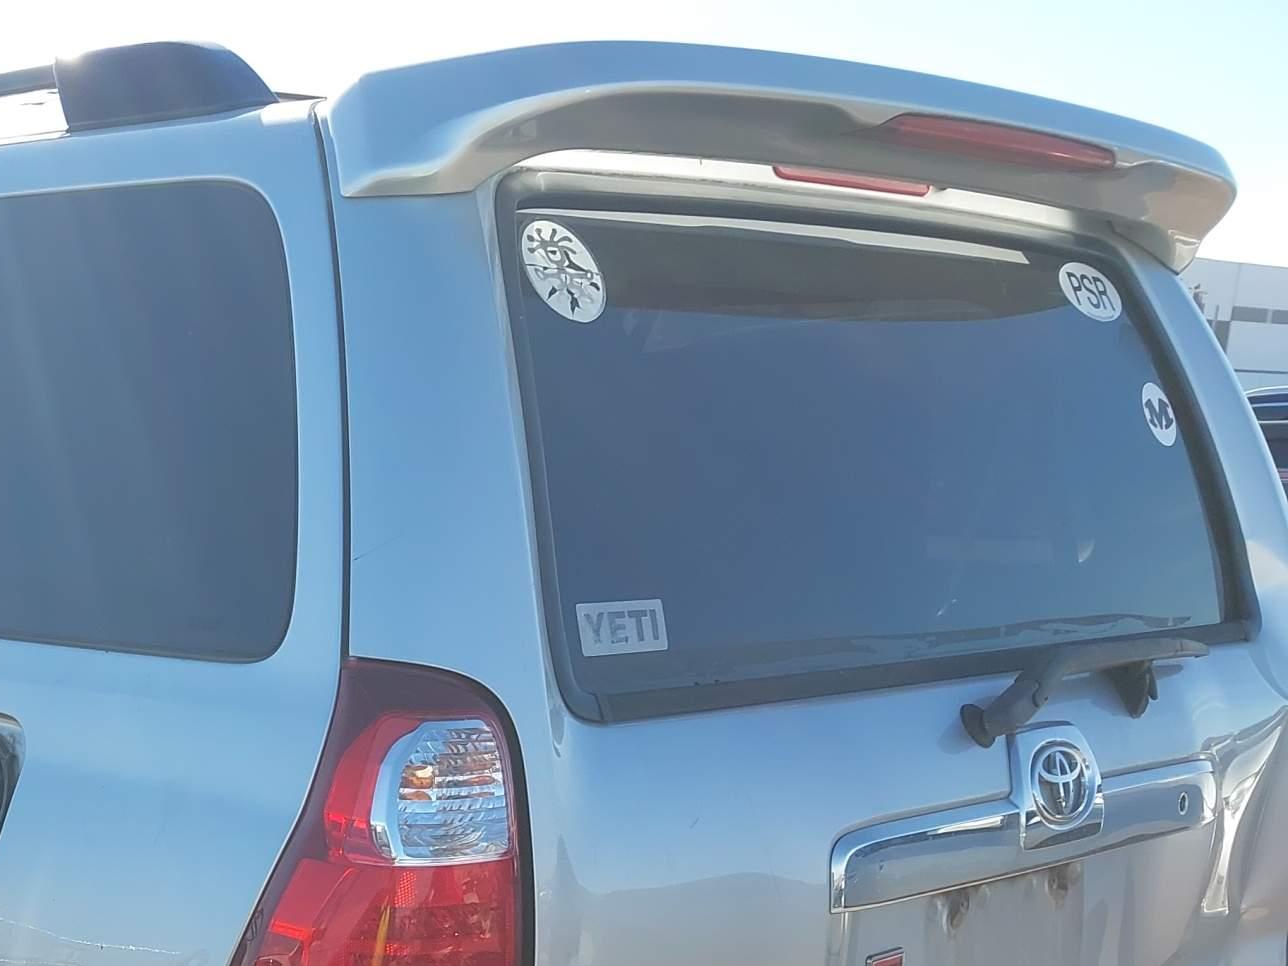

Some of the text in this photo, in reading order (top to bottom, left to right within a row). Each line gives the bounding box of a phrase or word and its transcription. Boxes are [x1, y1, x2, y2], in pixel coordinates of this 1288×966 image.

[1065, 270, 1116, 312] PSR
[1144, 398, 1175, 431] M
[583, 608, 661, 644] YETI
